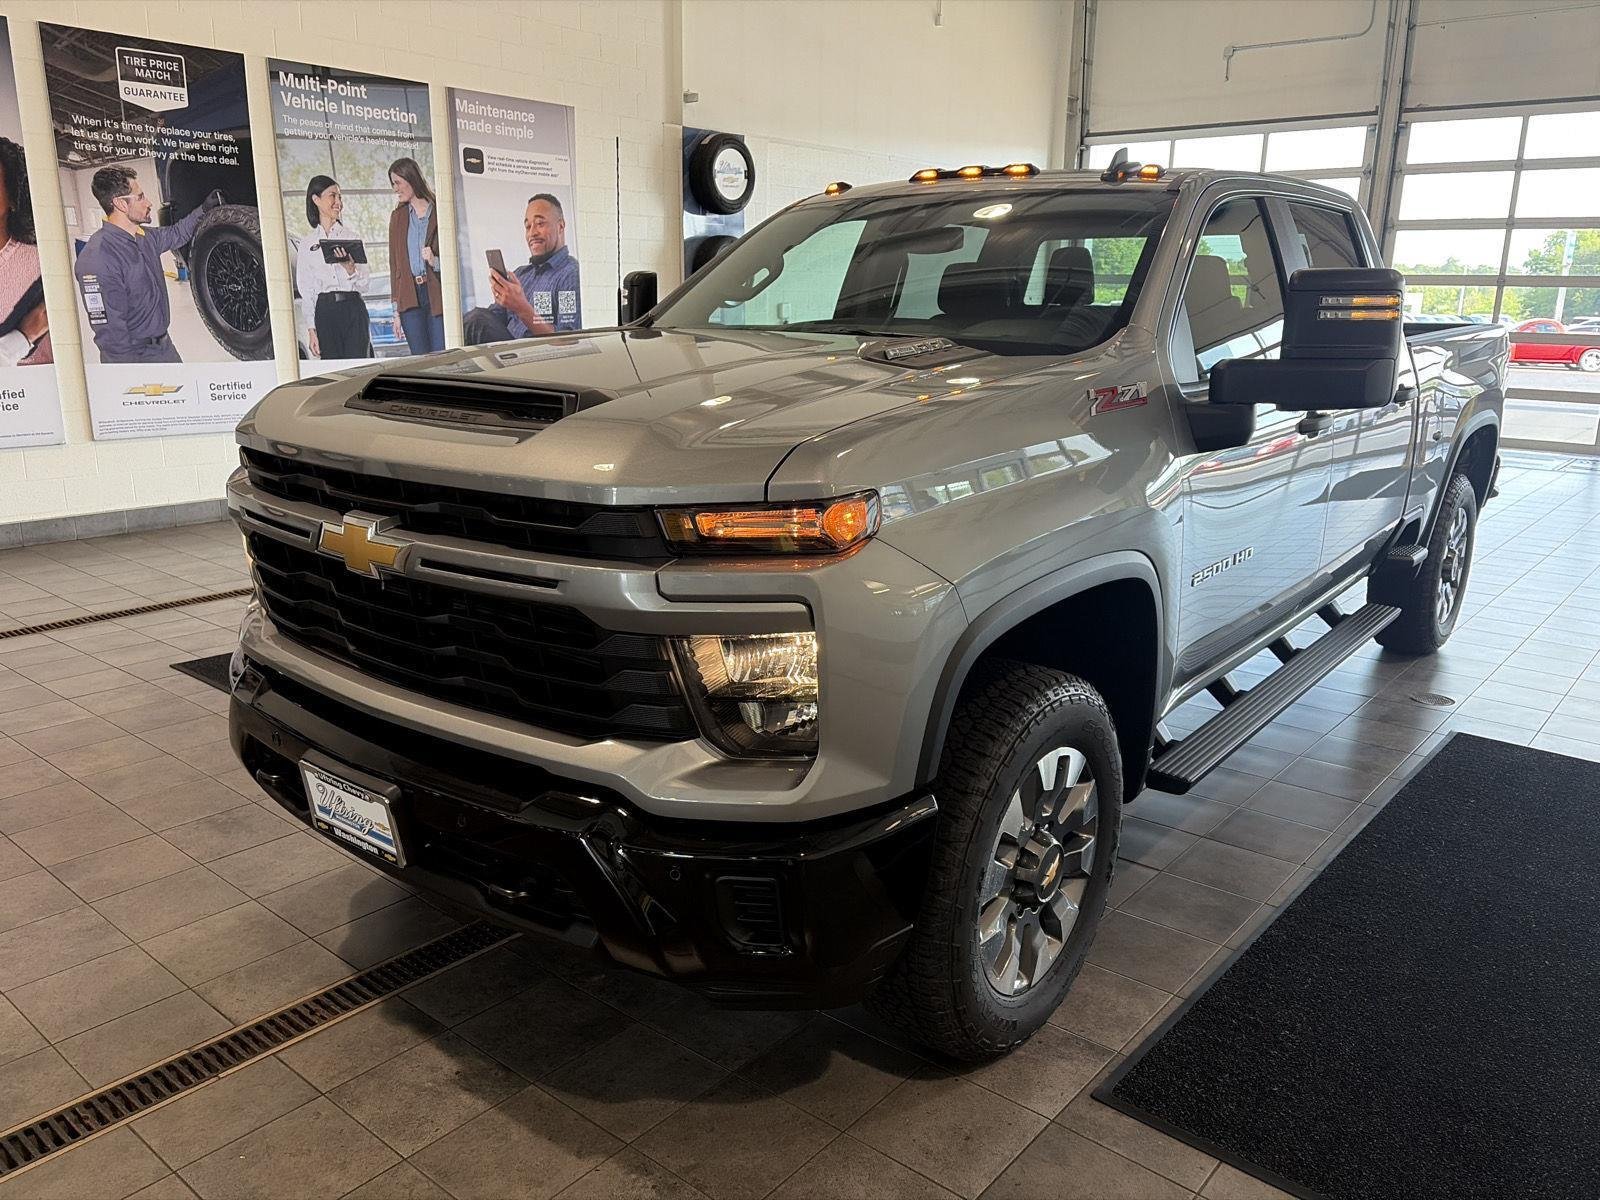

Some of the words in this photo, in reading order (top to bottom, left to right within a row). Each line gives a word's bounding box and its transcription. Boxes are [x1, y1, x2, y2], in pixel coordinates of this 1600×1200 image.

[123, 55, 147, 67] TIRE
[150, 59, 179, 72] PRICE
[135, 68, 171, 81] MATCH
[123, 86, 185, 102] GUARANTEE
[278, 70, 368, 99] Multi-Point
[280, 91, 338, 114] Vehicle
[341, 100, 417, 125] Inspection
[455, 98, 535, 123] Maintenance
[71, 114, 101, 127] When
[104, 118, 119, 129] it's
[121, 121, 143, 132] time
[145, 124, 155, 133] to
[157, 126, 190, 138] replace
[192, 131, 211, 140] your
[213, 130, 236, 143] tires,
[282, 114, 298, 124] The
[299, 118, 324, 128] peace
[325, 120, 333, 128] of
[334, 122, 354, 132] mind
[355, 124, 370, 134] that
[372, 127, 395, 137] comes
[397, 129, 415, 139] from
[284, 127, 313, 139] getting
[314, 132, 332, 141] your
[332, 132, 365, 145] vehicle's
[366, 136, 389, 147] health
[456, 118, 492, 134] made
[495, 122, 534, 140] simple
[71, 127, 85, 138] let
[101, 130, 114, 141] do
[116, 132, 132, 143] the
[134, 136, 160, 146] work.
[161, 138, 177, 148] We
[179, 139, 200, 150] have
[201, 141, 217, 152] the
[218, 143, 239, 155] right
[74, 141, 97, 152] tires
[98, 143, 114, 153] for
[115, 146, 136, 157] your
[138, 148, 167, 161] Chevy
[169, 151, 179, 160] at
[181, 151, 196, 161] the
[197, 153, 217, 164] best
[219, 155, 240, 166] deal.
[209, 381, 252, 391] Certified
[210, 392, 247, 401] Service
[123, 399, 186, 407] CHEVROLET
[1087, 381, 1148, 417] Z71
[389, 404, 484, 423] CHEVROLET
[1191, 556, 1232, 587] 2500
[1232, 546, 1254, 566] HD
[333, 827, 379, 855] Washington
